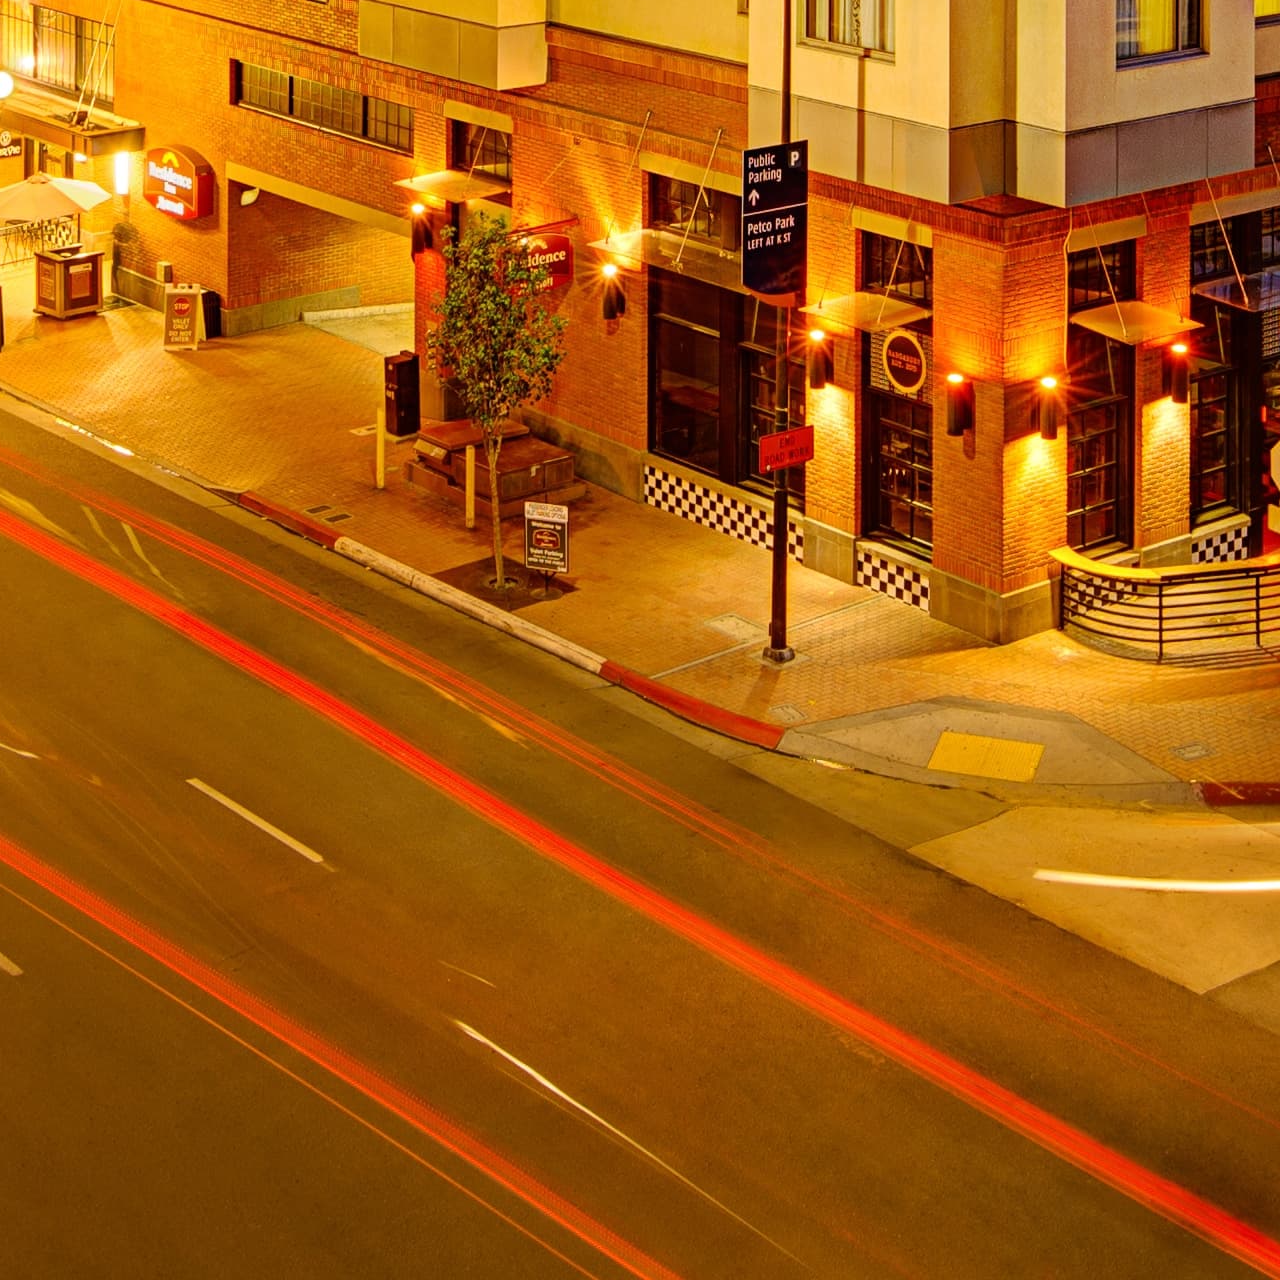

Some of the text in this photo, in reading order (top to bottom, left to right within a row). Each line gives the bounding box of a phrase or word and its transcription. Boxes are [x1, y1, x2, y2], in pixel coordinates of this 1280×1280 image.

[748, 151, 800, 169] Public P
[748, 167, 782, 184] Parking
[747, 214, 795, 236] Petco Park
[747, 232, 792, 250] LEFT AT K ST
[764, 447, 809, 465] ROAD WORK
